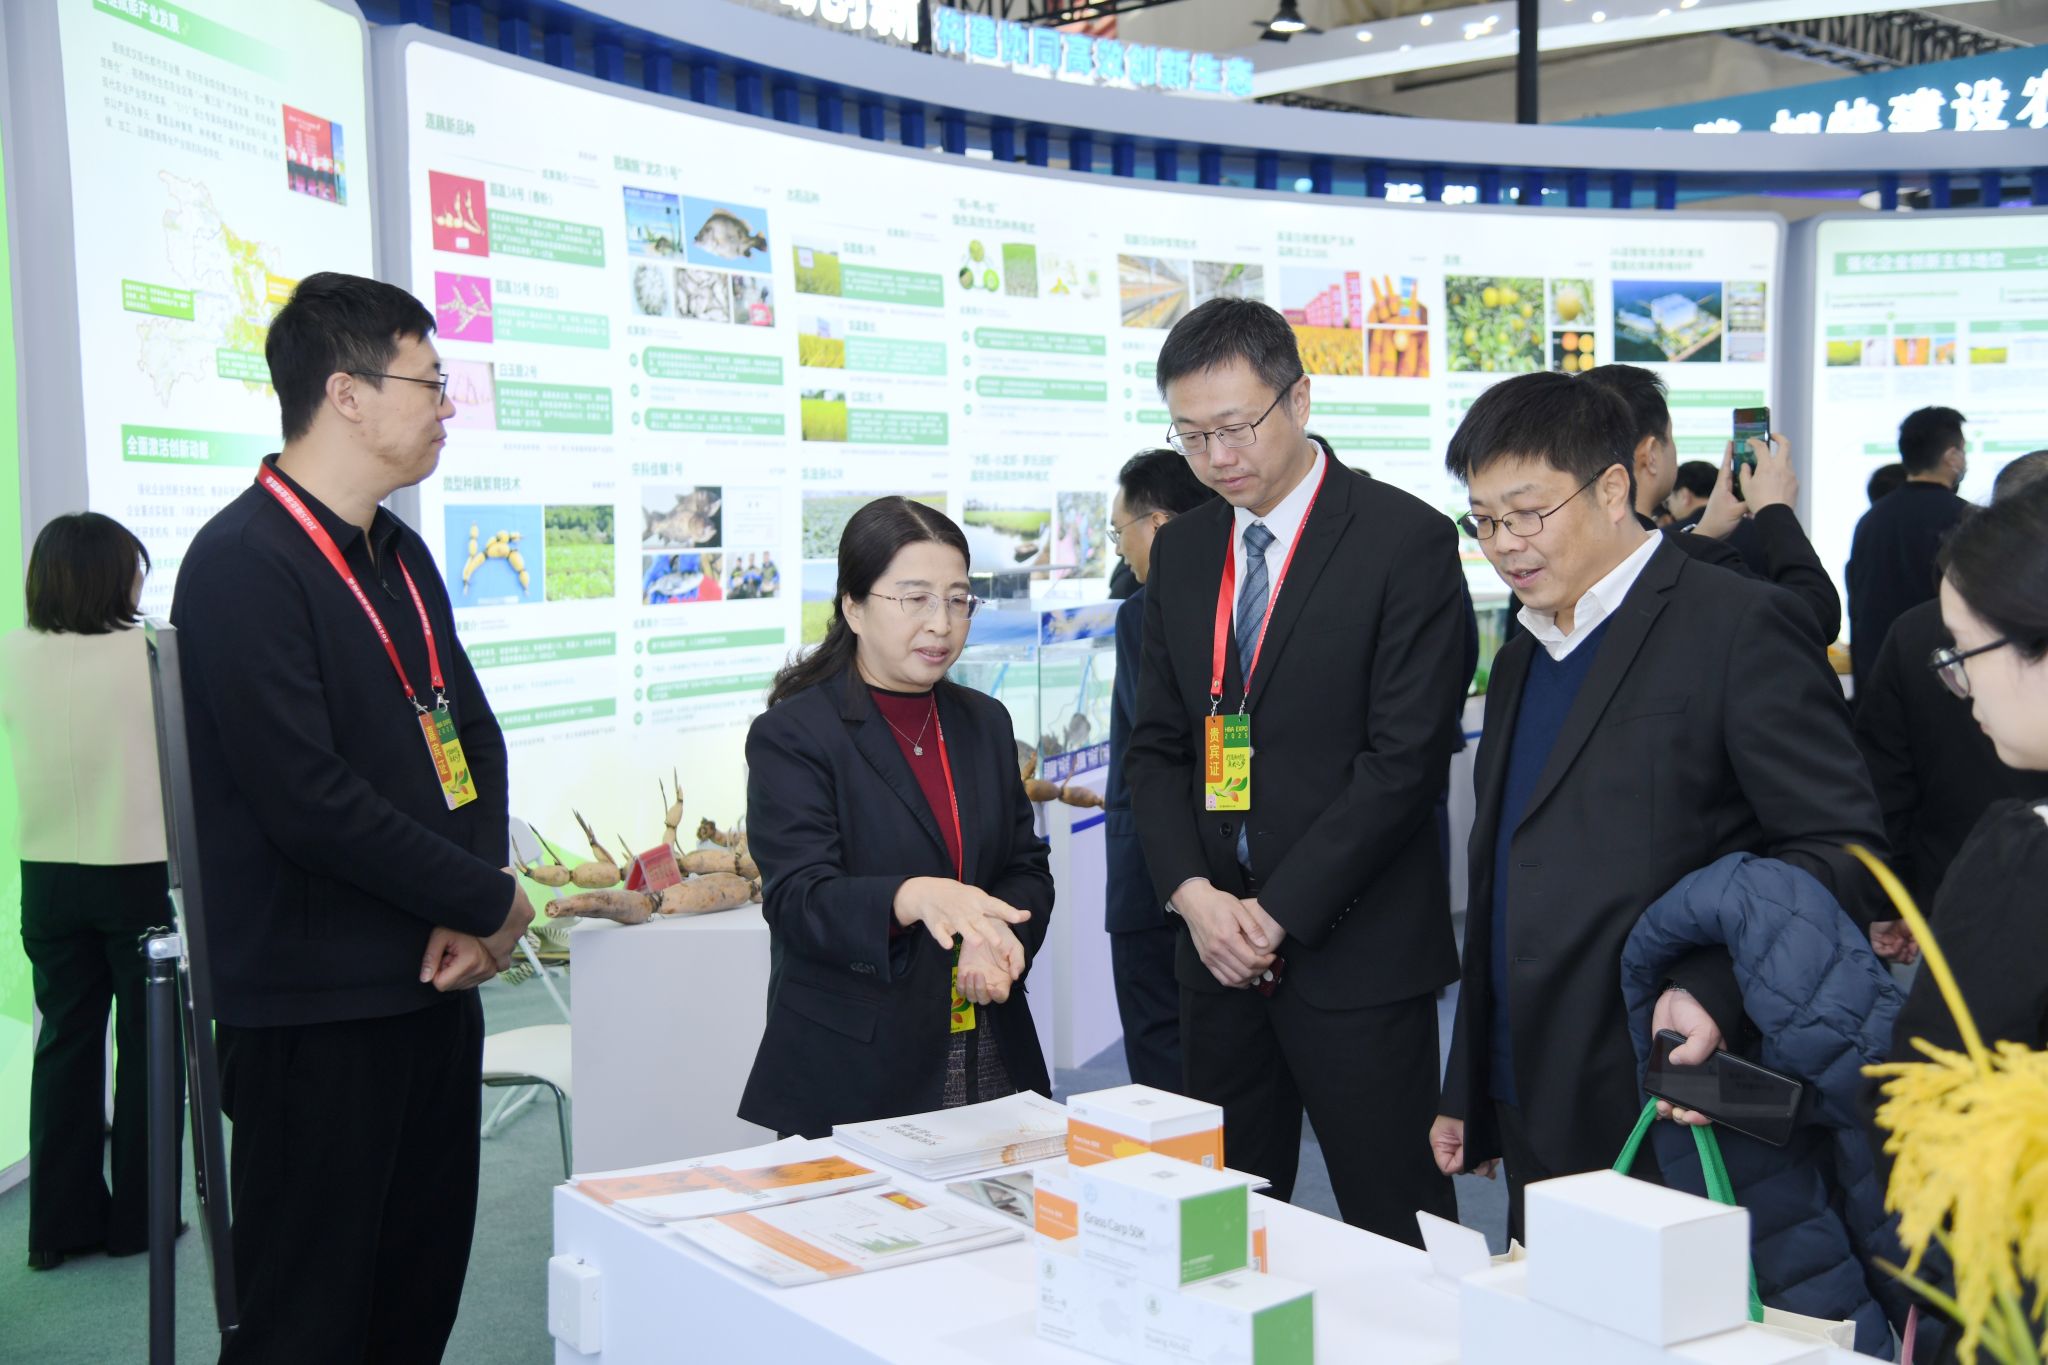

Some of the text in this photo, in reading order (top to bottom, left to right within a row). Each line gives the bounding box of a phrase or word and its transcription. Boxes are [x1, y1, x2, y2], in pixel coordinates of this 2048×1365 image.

[931, 6, 1254, 97] 构建协同高效创新生态
[1208, 726, 1220, 777] 贵宾证
[1083, 1211, 1107, 1228] Grass
[1108, 1218, 1128, 1236] Carp
